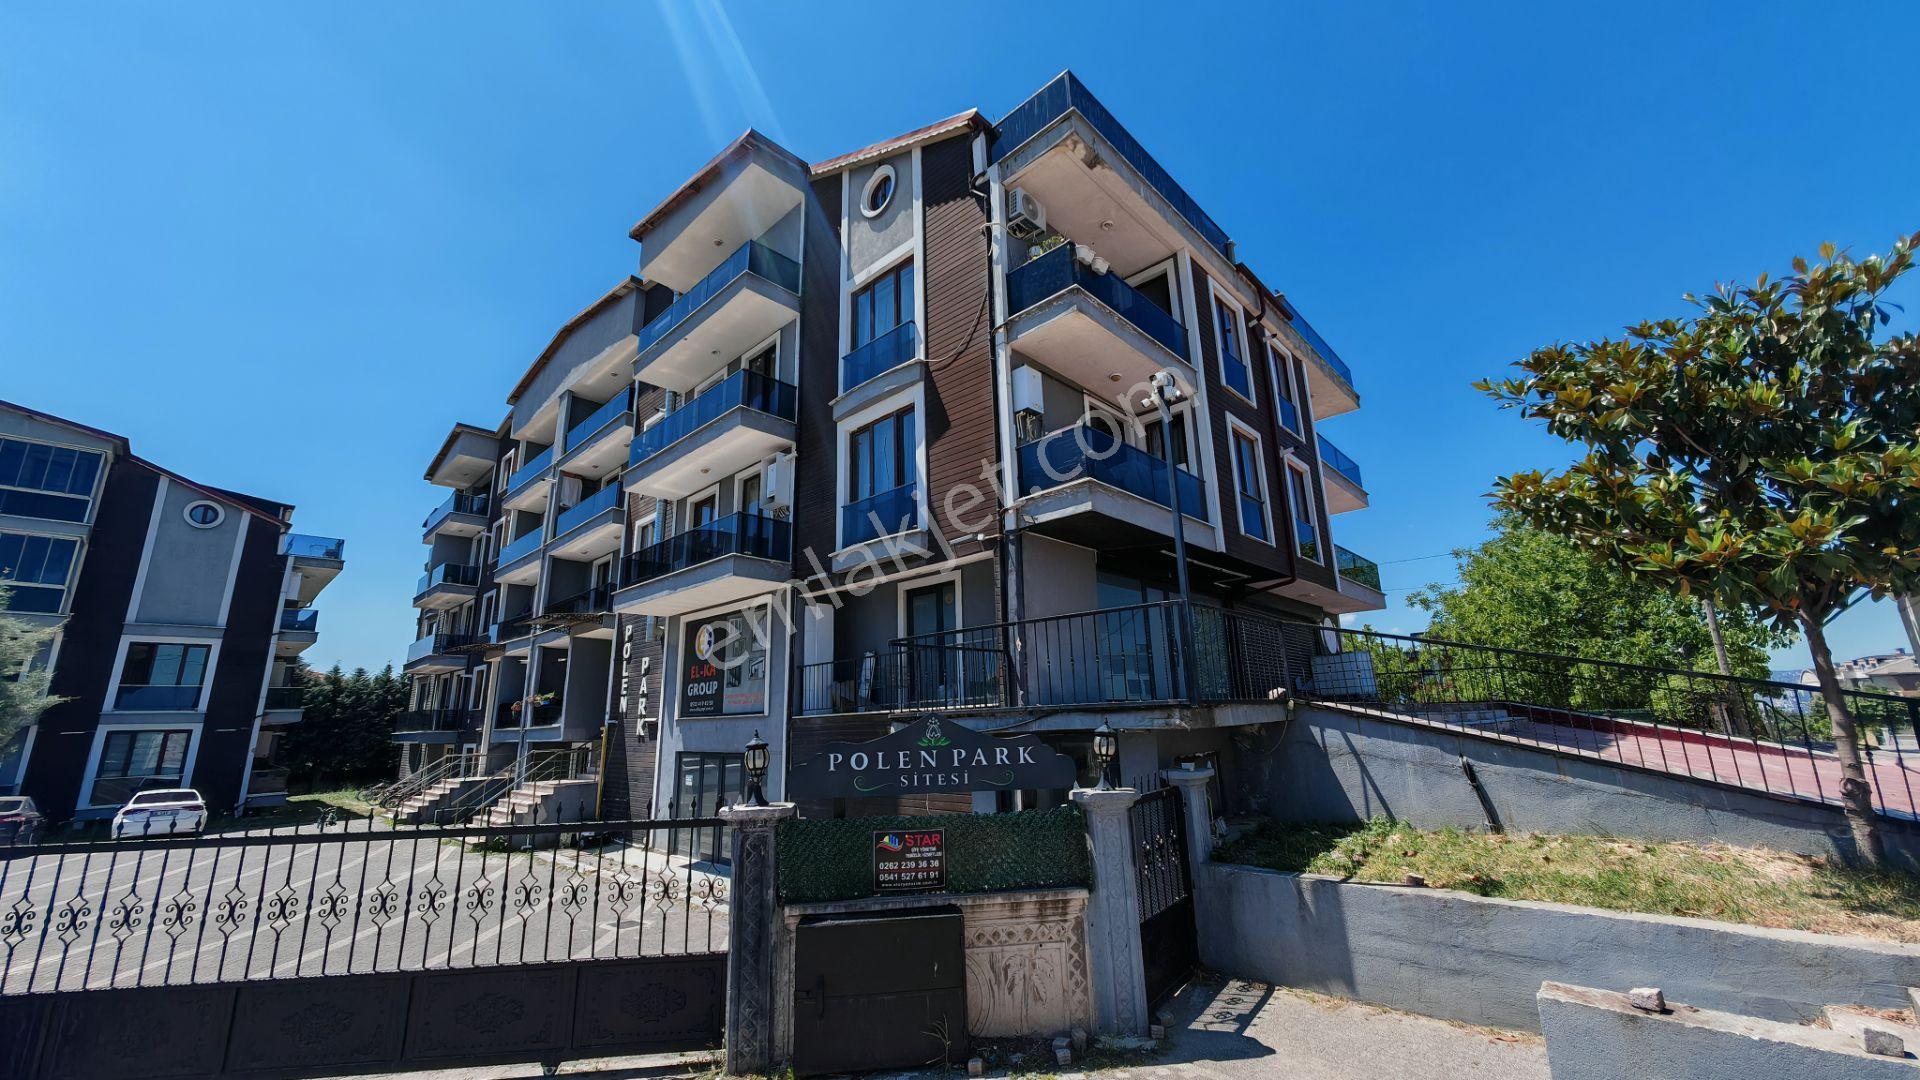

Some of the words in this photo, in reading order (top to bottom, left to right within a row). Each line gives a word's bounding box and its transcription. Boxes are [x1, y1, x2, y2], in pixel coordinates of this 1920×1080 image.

[619, 624, 633, 713] POLEN
[690, 664, 715, 679] EL-KA
[636, 657, 650, 735] PARK
[687, 681, 718, 697] GROUP
[828, 750, 937, 772] POLEN
[952, 746, 1037, 767] PARK
[900, 769, 969, 788] SİTESİ
[905, 834, 941, 846] STAR
[879, 862, 899, 870] 0262
[879, 873, 898, 881] 0541
[929, 871, 939, 879] 91
